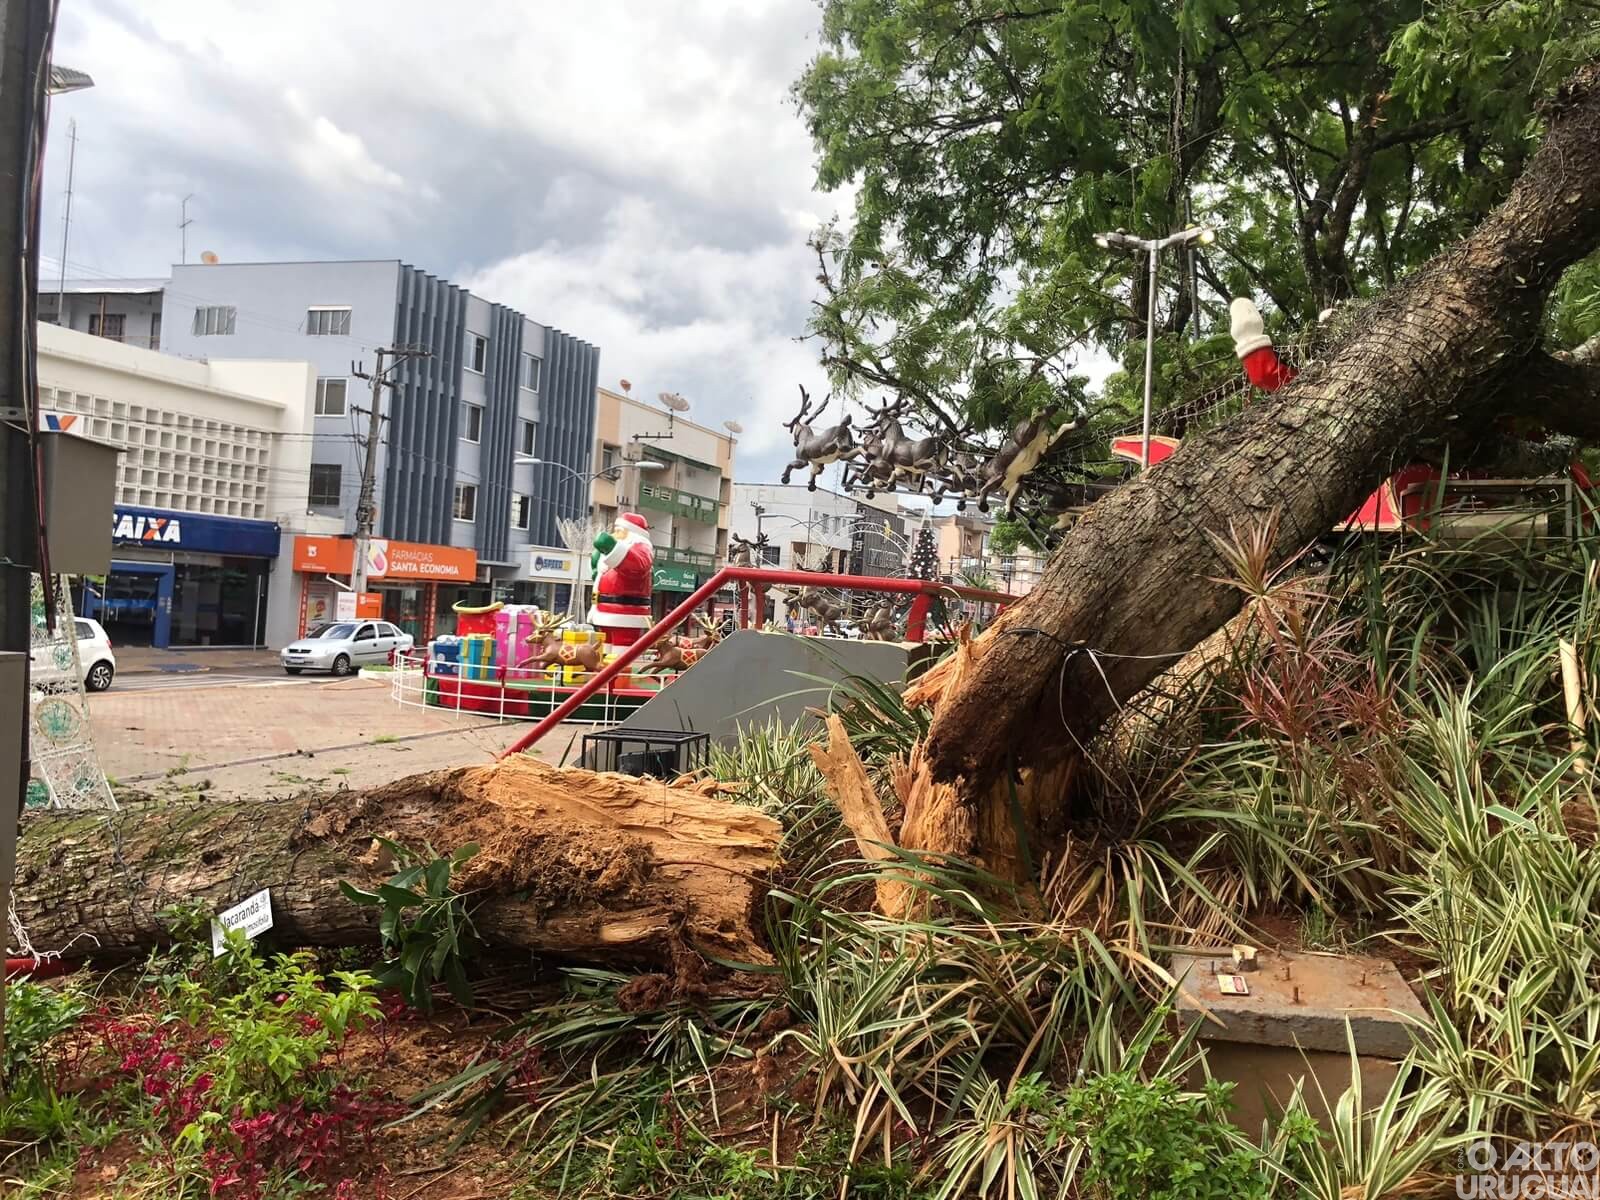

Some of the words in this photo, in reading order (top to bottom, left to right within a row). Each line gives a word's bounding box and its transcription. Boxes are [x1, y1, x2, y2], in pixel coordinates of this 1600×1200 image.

[391, 548, 433, 562] FARMÁCIAS
[391, 560, 418, 572] SANTA
[420, 562, 459, 575] ECONOMIA
